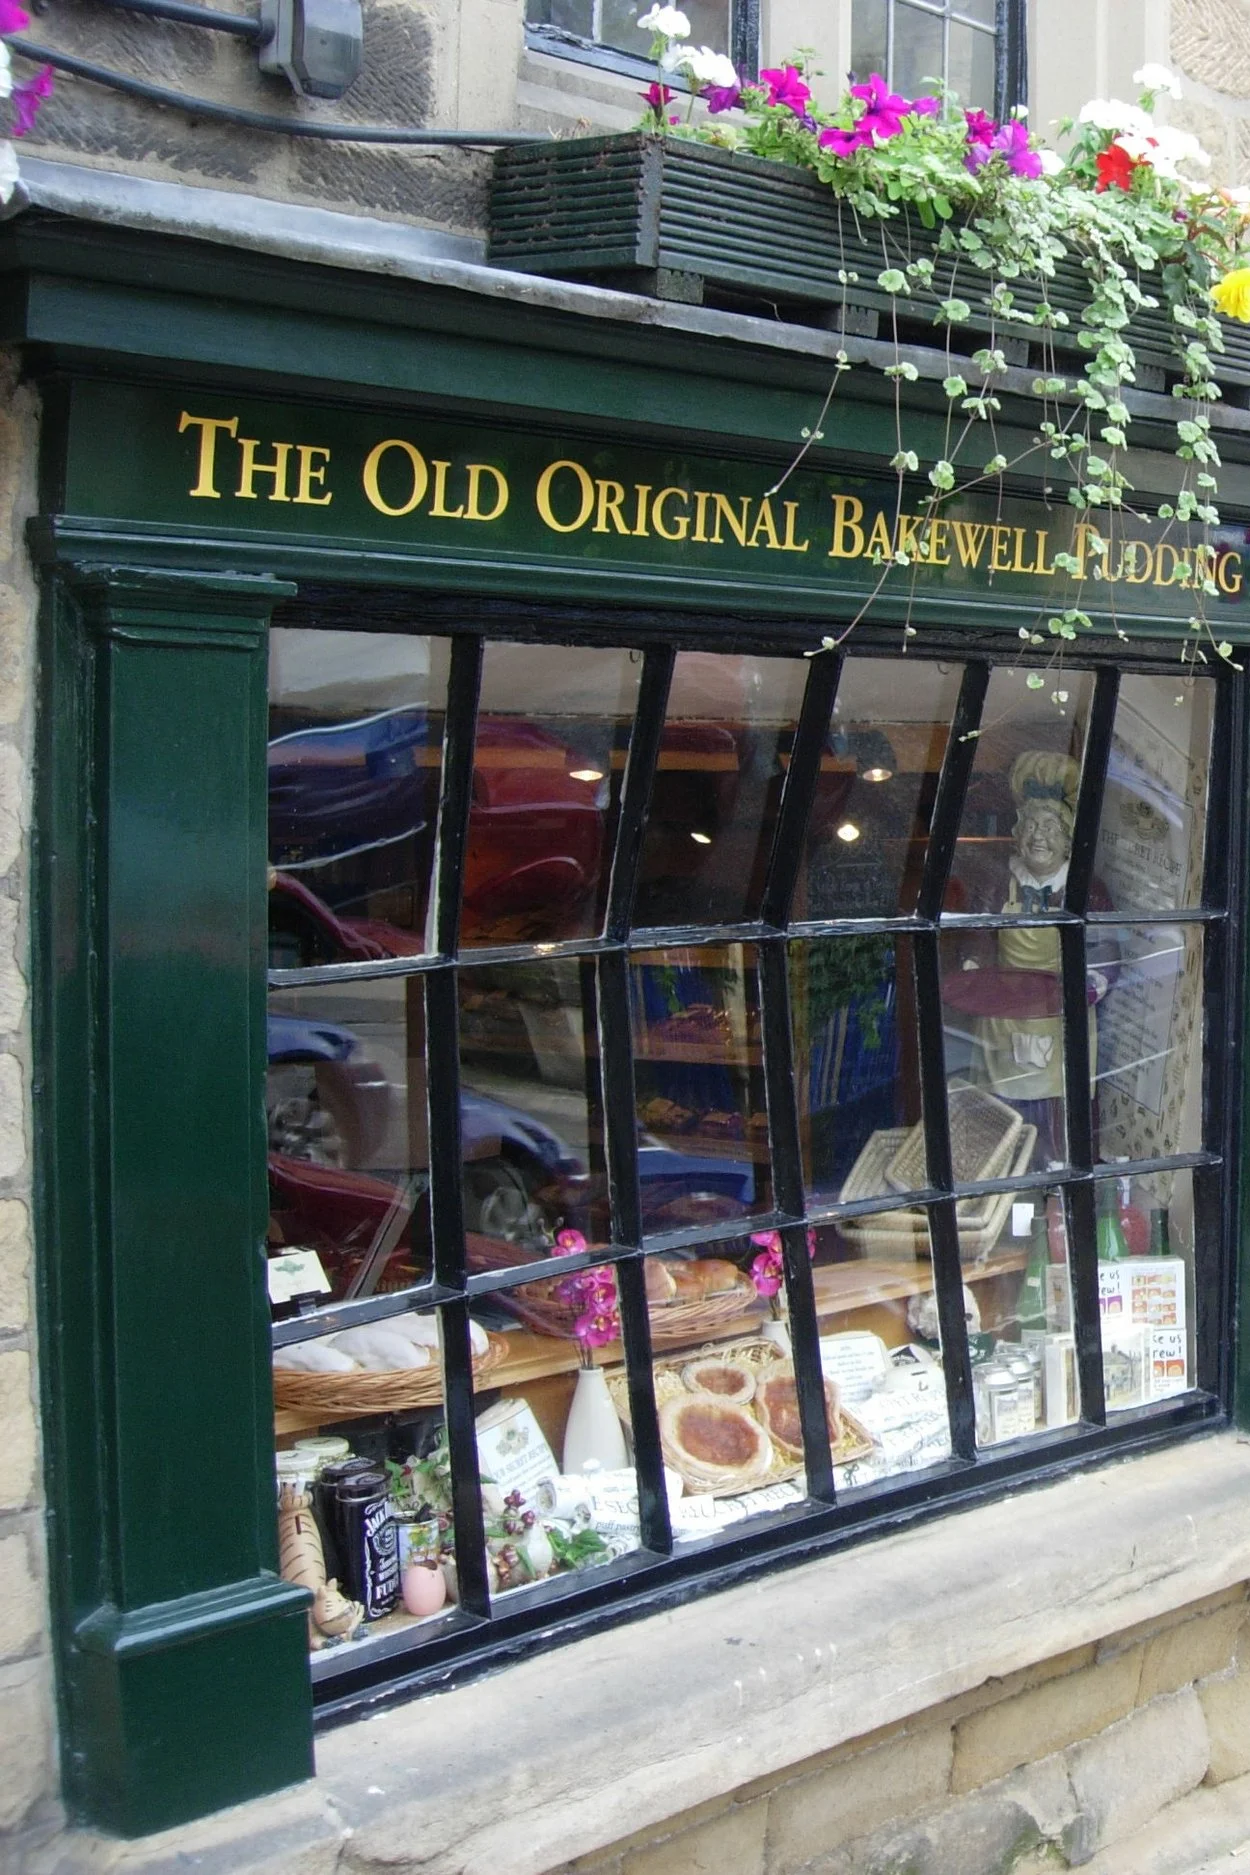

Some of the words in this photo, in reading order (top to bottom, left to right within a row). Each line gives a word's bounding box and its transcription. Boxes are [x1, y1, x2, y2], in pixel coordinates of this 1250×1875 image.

[178, 410, 333, 507] THE
[363, 439, 509, 522] OLD
[536, 460, 809, 553] ORIGINAL
[828, 493, 1056, 576] BAKEWELL
[1071, 523, 1243, 593] PUDDING
